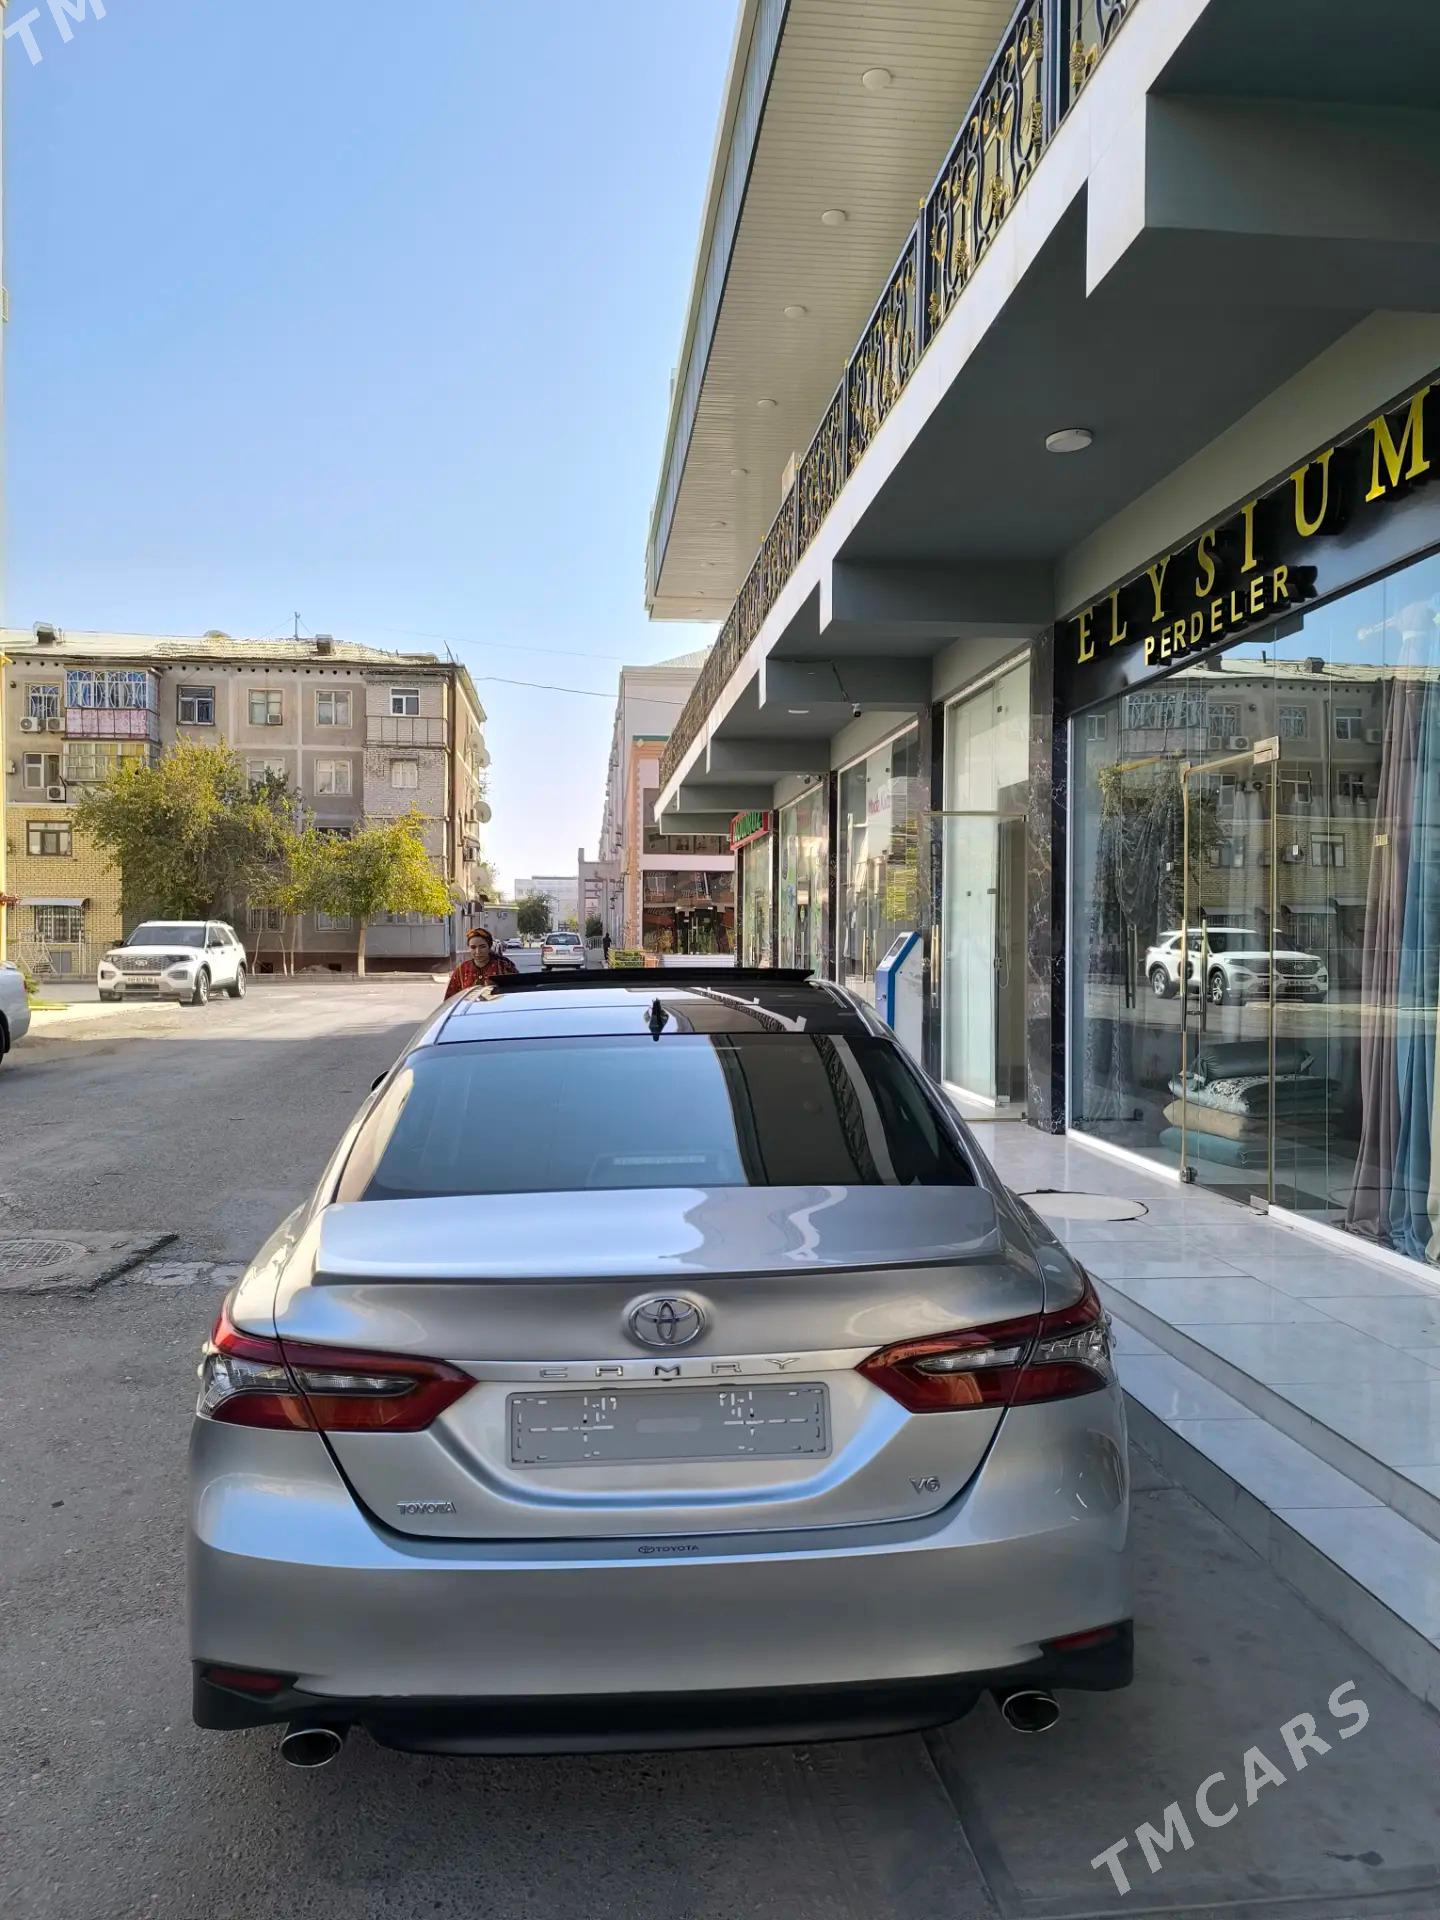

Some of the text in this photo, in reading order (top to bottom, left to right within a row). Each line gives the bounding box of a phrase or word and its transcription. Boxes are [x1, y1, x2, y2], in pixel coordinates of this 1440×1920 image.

[1077, 384, 1431, 665] ELYSIUM
[1144, 564, 1288, 666] PERDELER
[539, 1357, 801, 1379] CAMRY
[909, 1475, 940, 1495] V6
[396, 1501, 456, 1516] TOYOTA
[655, 1544, 699, 1553] TOYOTA
